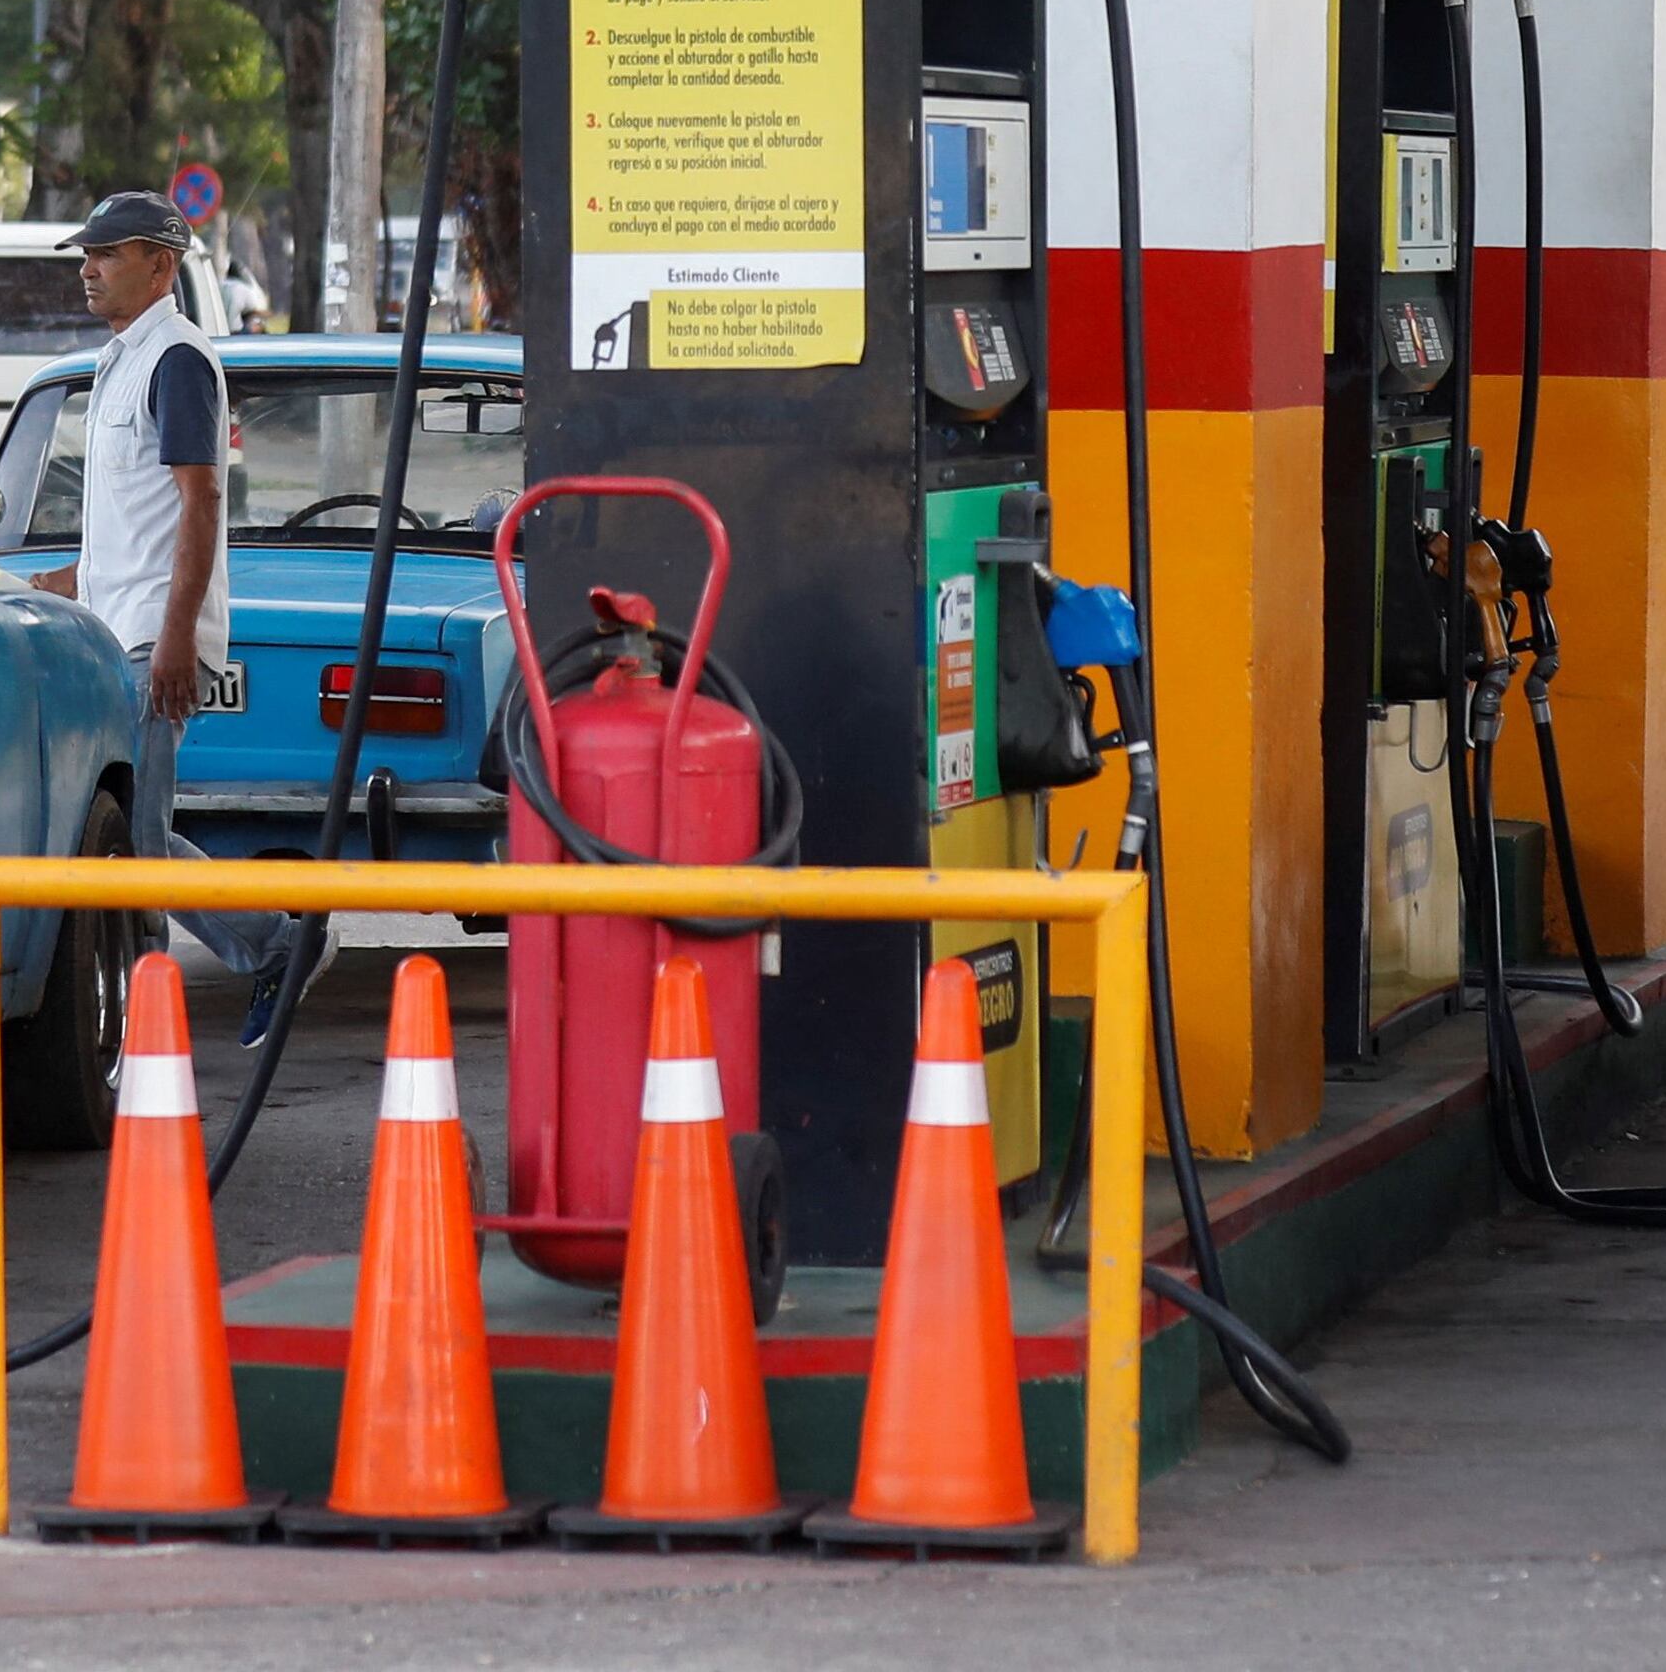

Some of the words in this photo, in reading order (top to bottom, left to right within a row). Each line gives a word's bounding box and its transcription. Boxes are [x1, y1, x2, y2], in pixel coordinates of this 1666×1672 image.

[585, 30, 601, 45] 2.
[608, 27, 672, 48] Descuelgue
[675, 27, 686, 44] la
[689, 27, 727, 47] pistola
[730, 27, 744, 43] de
[747, 26, 815, 43] combustible
[607, 54, 615, 69] y
[618, 50, 660, 65] accione
[664, 48, 674, 64] el
[678, 48, 733, 65] obturador
[738, 52, 745, 64] o
[749, 47, 783, 67] gatillo
[787, 47, 818, 64] hasta
[608, 70, 663, 90] completar
[668, 70, 678, 86] la
[682, 69, 730, 86] cantidad
[734, 68, 784, 85] deseada.
[586, 113, 601, 129] 3.
[608, 111, 653, 131] Coloque
[657, 113, 728, 128] nuevamente
[731, 110, 742, 127] la
[745, 110, 783, 130] pistola
[786, 115, 800, 127] en
[608, 138, 621, 149] su
[624, 135, 670, 151] soporte,
[674, 132, 725, 151] verifique
[728, 137, 749, 151] que
[753, 131, 764, 148] el
[767, 130, 823, 148] obturador
[655, 159, 662, 169] a
[665, 158, 678, 169] su
[681, 154, 727, 172] posición
[731, 153, 767, 169] inicial.
[587, 197, 603, 212] 4.
[609, 197, 623, 212] En
[626, 200, 650, 212] caso
[654, 200, 675, 215] que
[679, 197, 731, 215] requiera,
[780, 193, 790, 210] al
[793, 196, 828, 214] cajero
[832, 199, 839, 214] y
[609, 215, 658, 236] concluya
[662, 216, 672, 232] el
[676, 220, 704, 236] pago
[708, 220, 727, 232] con
[731, 215, 741, 231] el
[744, 215, 780, 231] medio
[783, 215, 836, 231] acordado
[667, 268, 729, 283] Estimado
[733, 268, 780, 283] Cliente
[667, 300, 684, 316] No
[688, 299, 718, 316] debe
[720, 299, 757, 319] colgar
[761, 298, 773, 316] la
[777, 298, 817, 318] pistola
[667, 320, 700, 337] hasta
[704, 323, 719, 336] no
[723, 320, 757, 336] haber
[761, 320, 823, 336] habilitado
[668, 341, 679, 357] la
[683, 341, 733, 357] cantidad
[737, 340, 797, 357] solicitada.
